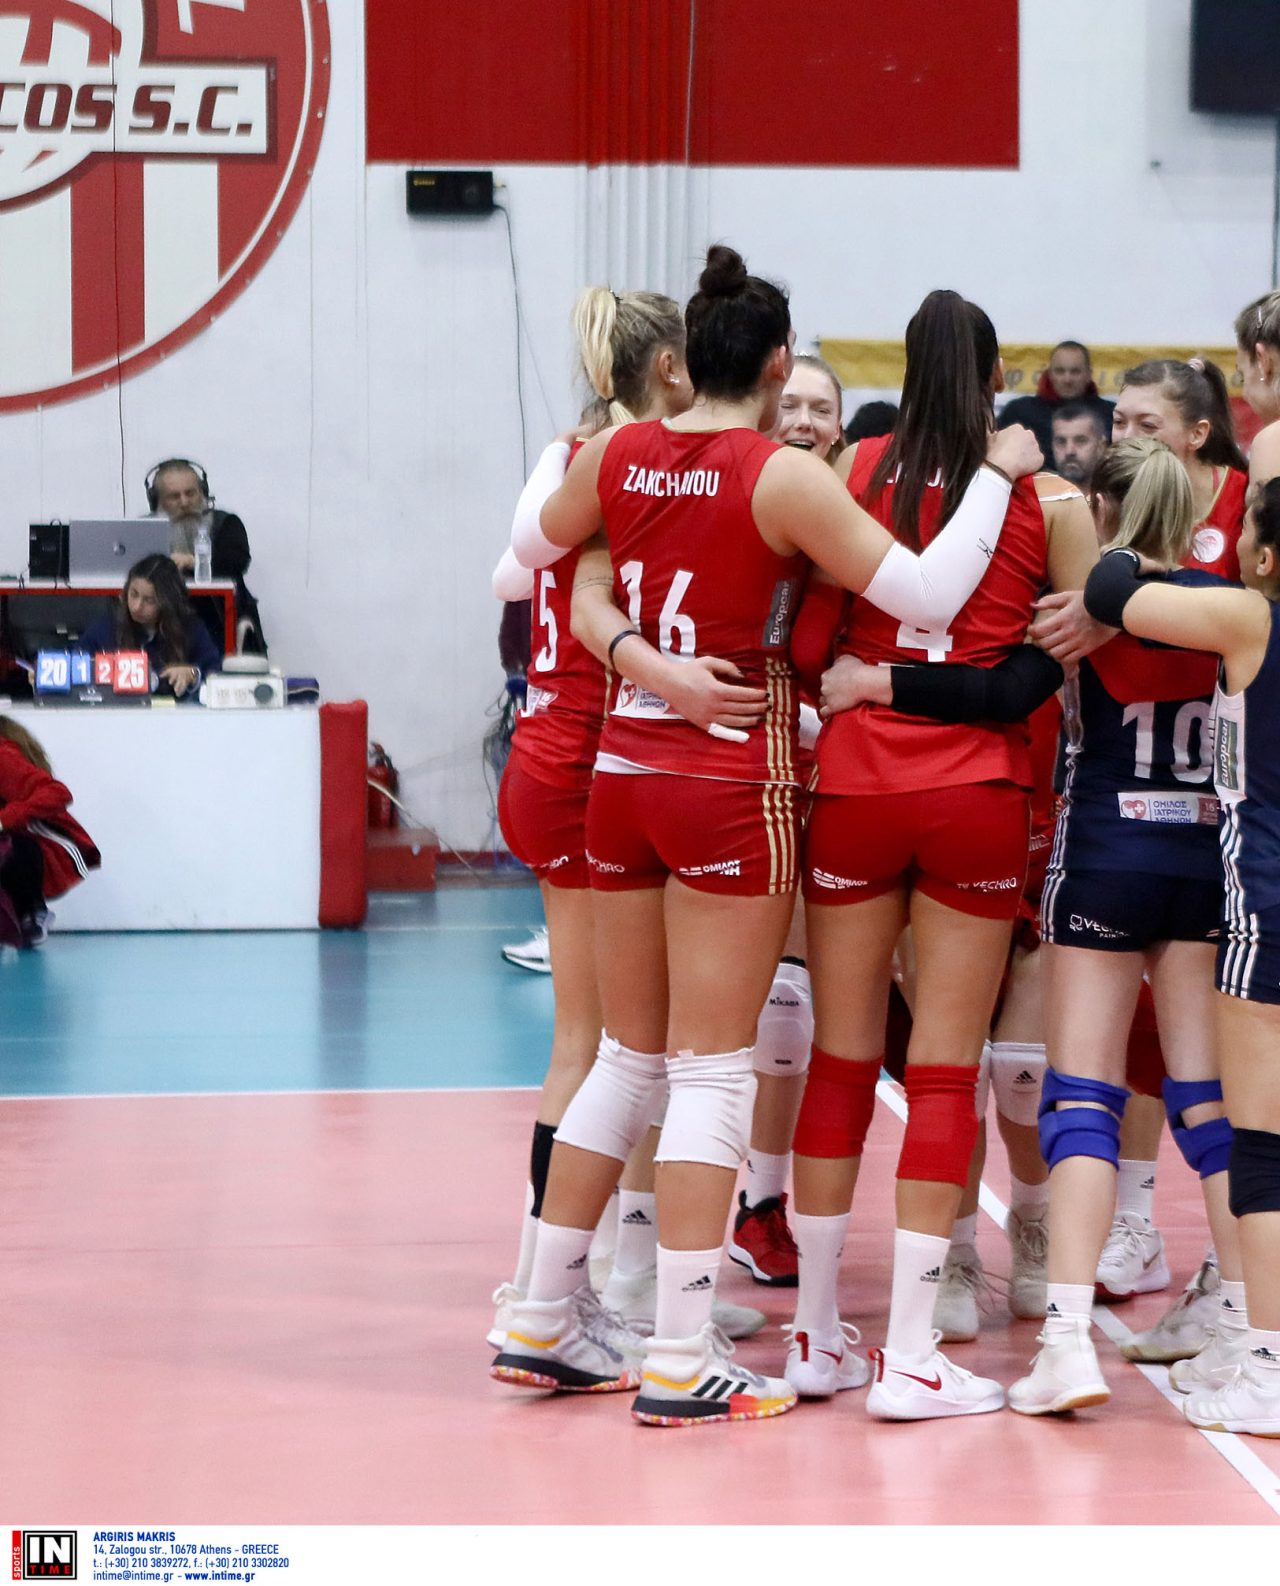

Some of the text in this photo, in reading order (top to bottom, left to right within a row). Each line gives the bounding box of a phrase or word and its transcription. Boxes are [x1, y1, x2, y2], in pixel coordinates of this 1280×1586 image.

[129, 85, 253, 136] S.C.
[619, 560, 697, 664] 16
[40, 658, 144, 689] 20 1 2 25
[1122, 701, 1215, 784] 10
[1221, 721, 1231, 788] Europcar
